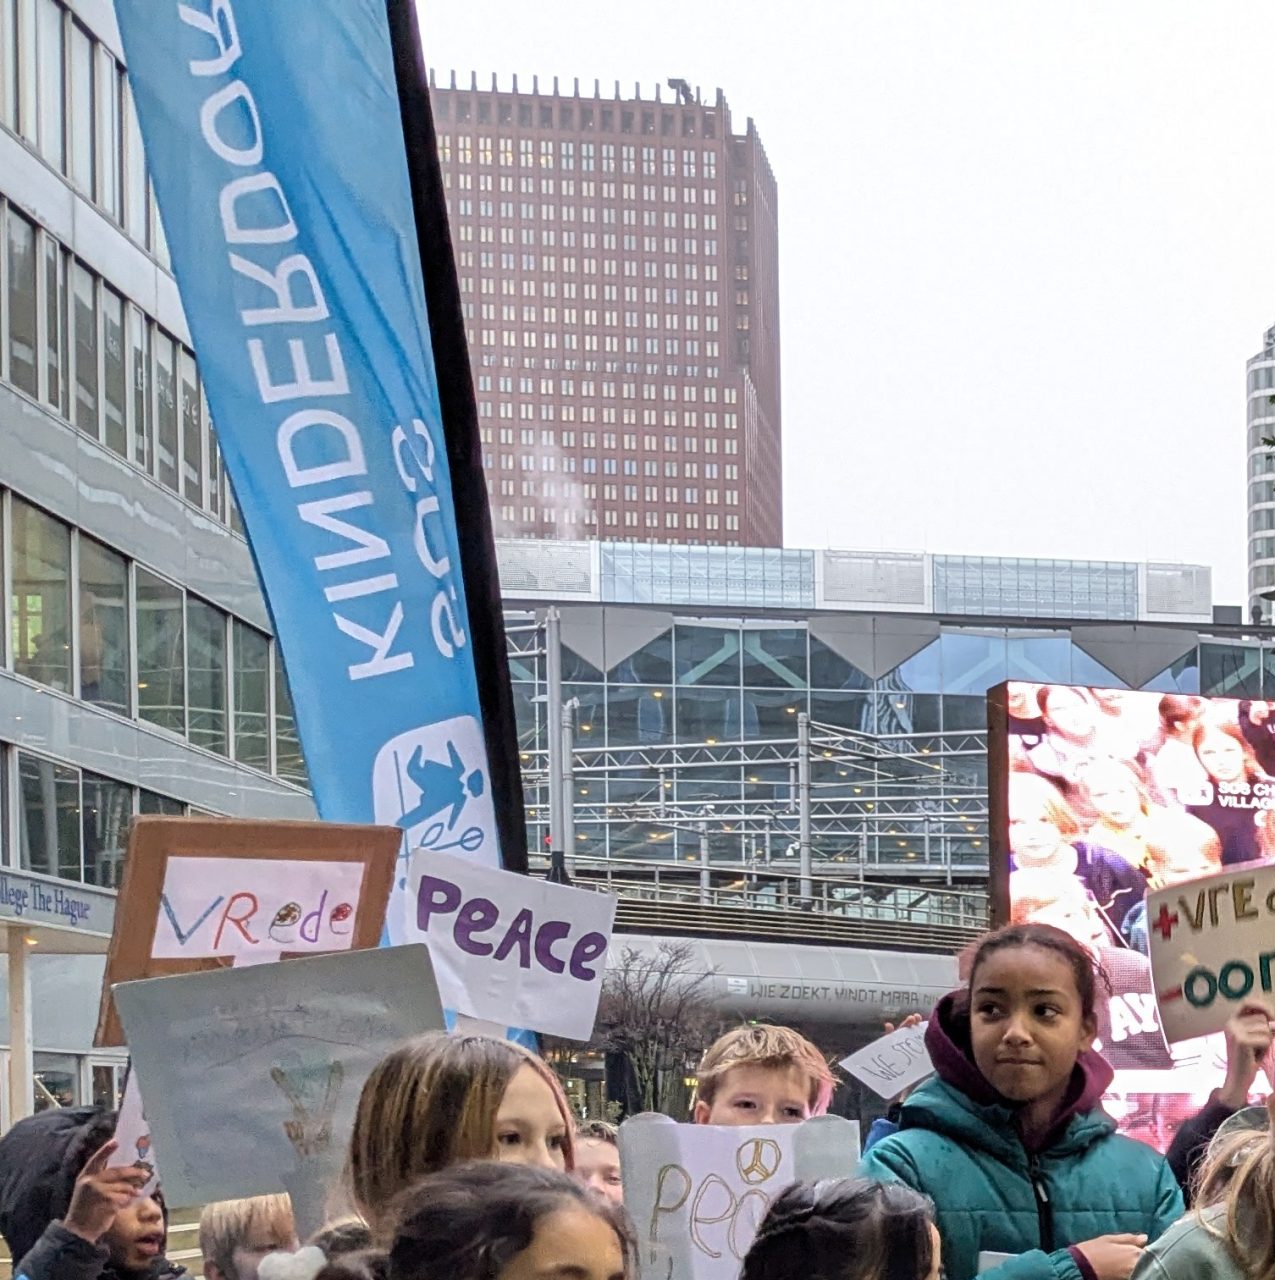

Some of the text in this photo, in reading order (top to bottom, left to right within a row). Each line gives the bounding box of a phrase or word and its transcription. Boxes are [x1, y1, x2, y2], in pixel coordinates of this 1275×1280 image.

[30, 883, 52, 912] The
[54, 888, 91, 926] Hague
[751, 984, 775, 998] WIE
